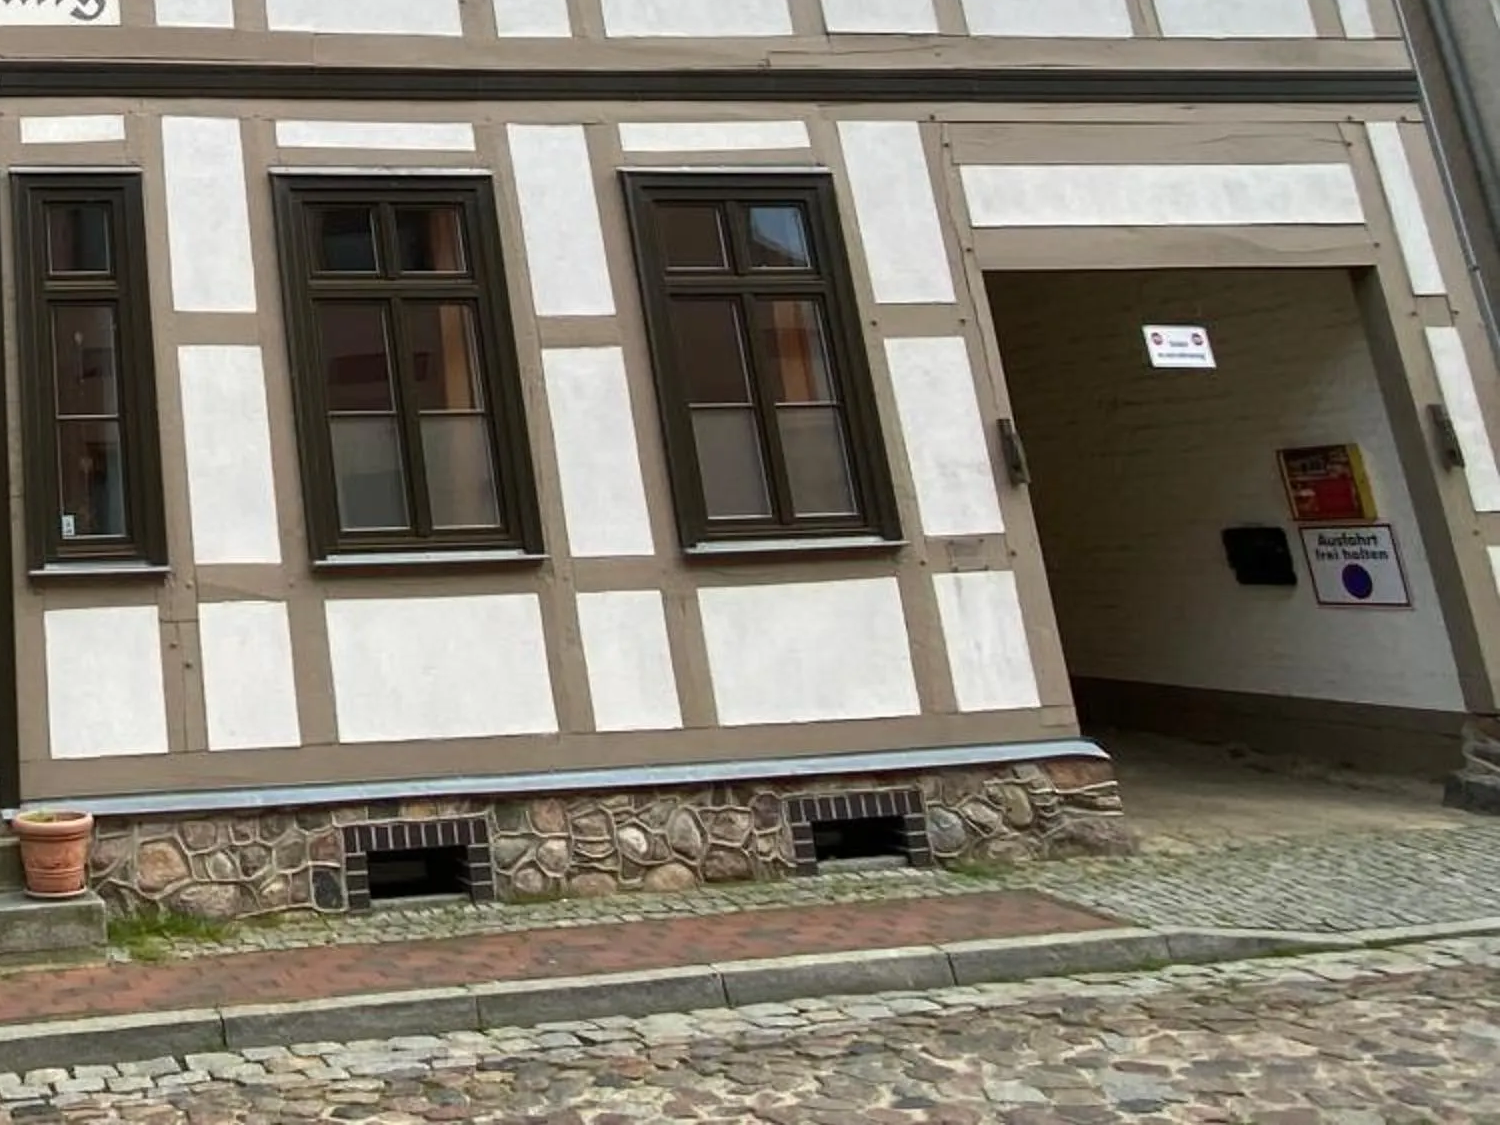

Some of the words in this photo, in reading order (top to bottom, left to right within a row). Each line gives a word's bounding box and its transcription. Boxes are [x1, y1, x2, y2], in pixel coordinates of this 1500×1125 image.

[1318, 533, 1378, 546] Ausfahrt
[1316, 548, 1339, 560] frei
[1342, 547, 1388, 560] halten
